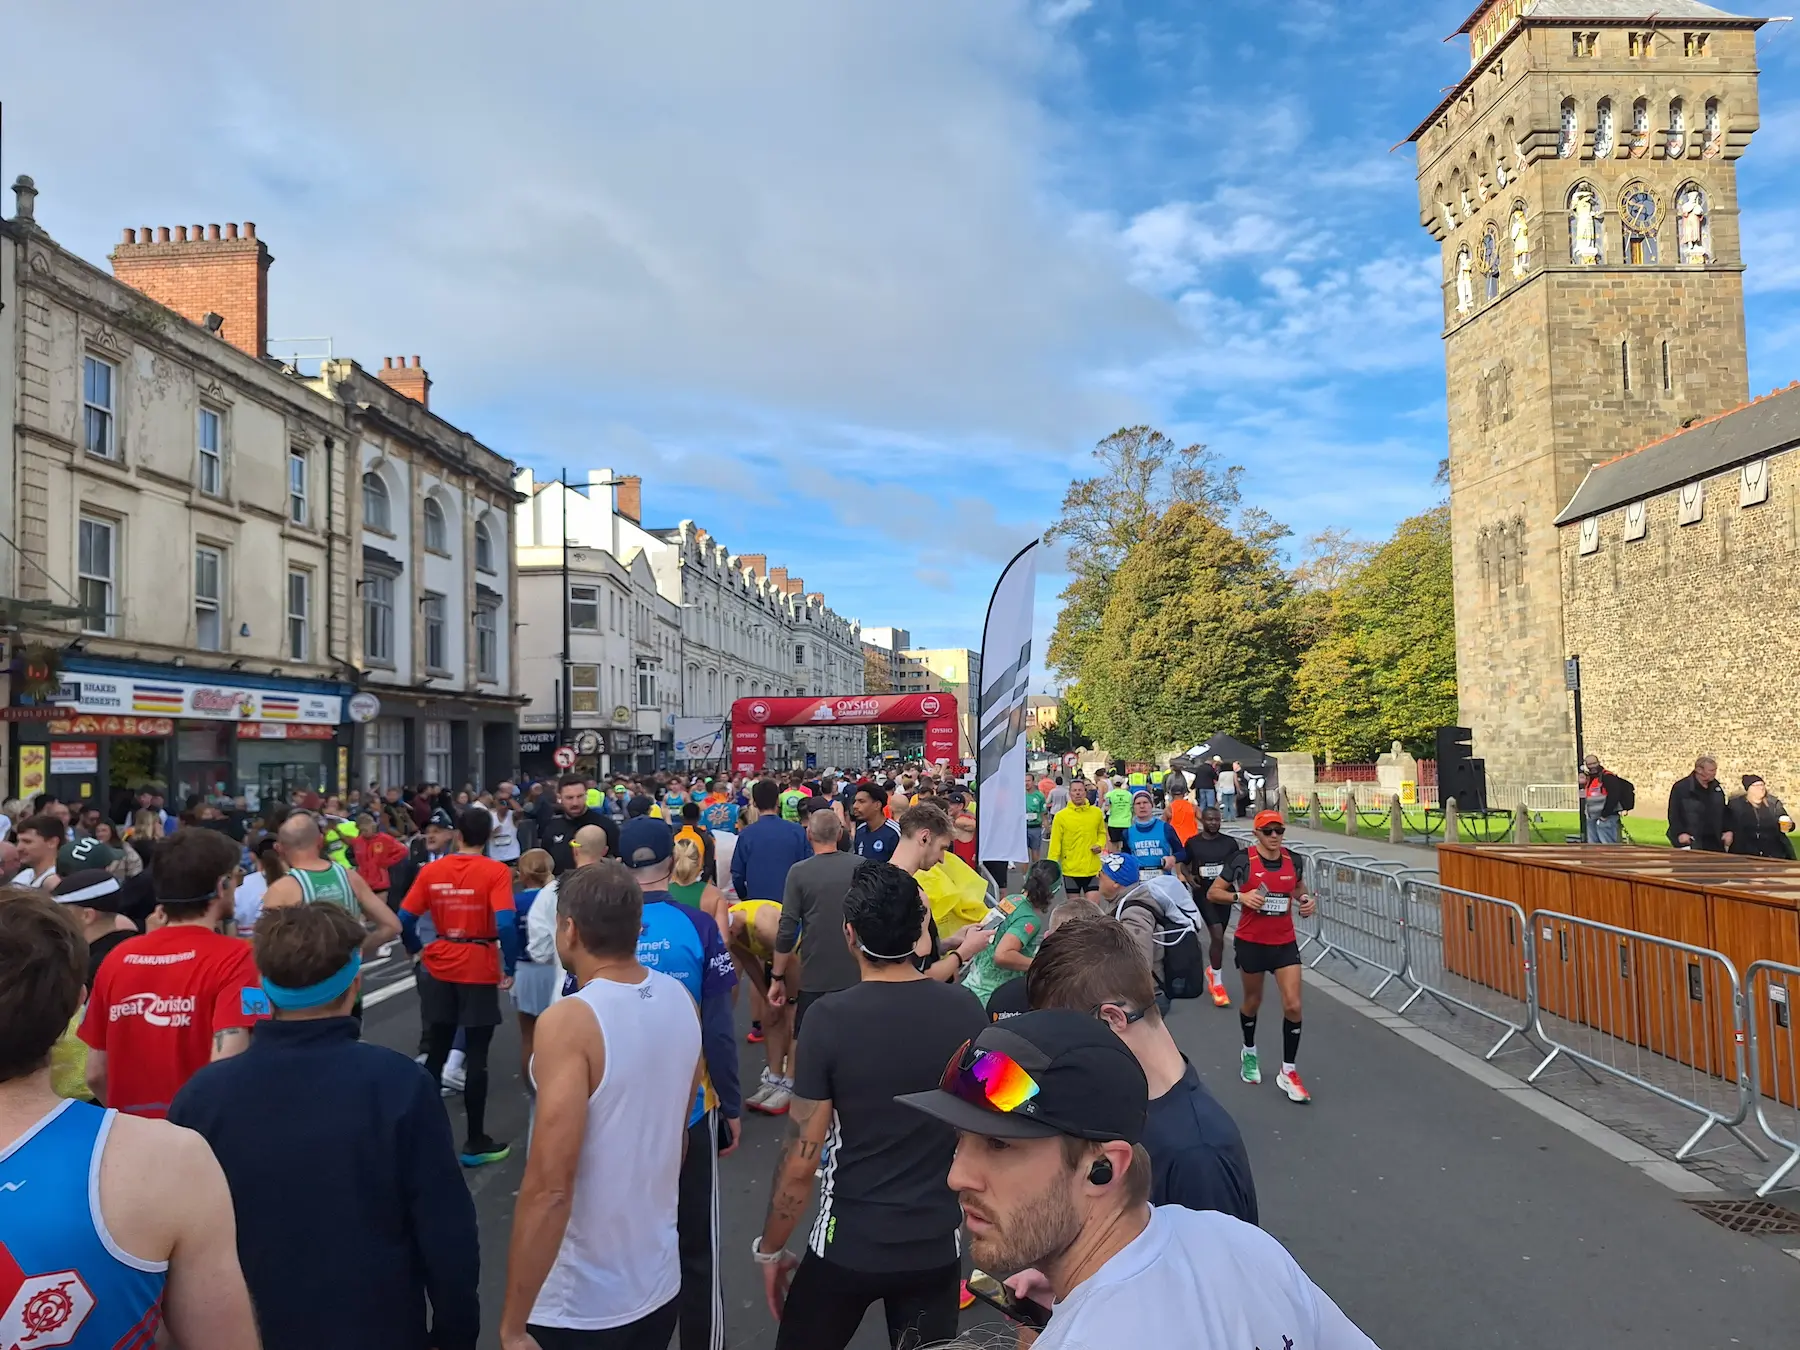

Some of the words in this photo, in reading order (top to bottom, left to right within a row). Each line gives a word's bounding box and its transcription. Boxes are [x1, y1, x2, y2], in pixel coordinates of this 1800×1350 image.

[83, 683, 117, 693] SHAKES
[837, 700, 879, 710] OYSHO
[519, 733, 556, 743] REWERY
[519, 743, 540, 752] OOM
[1134, 839, 1161, 849] WEEKLY
[1149, 847, 1164, 856] RUN
[637, 938, 671, 951] imer's
[637, 952, 659, 966] iety
[710, 951, 731, 969] Alzhe
[718, 961, 736, 977] Soc
[670, 971, 690, 979] hope
[109, 998, 145, 1022] great
[156, 995, 196, 1014] bristol
[170, 1013, 191, 1027] 10k
